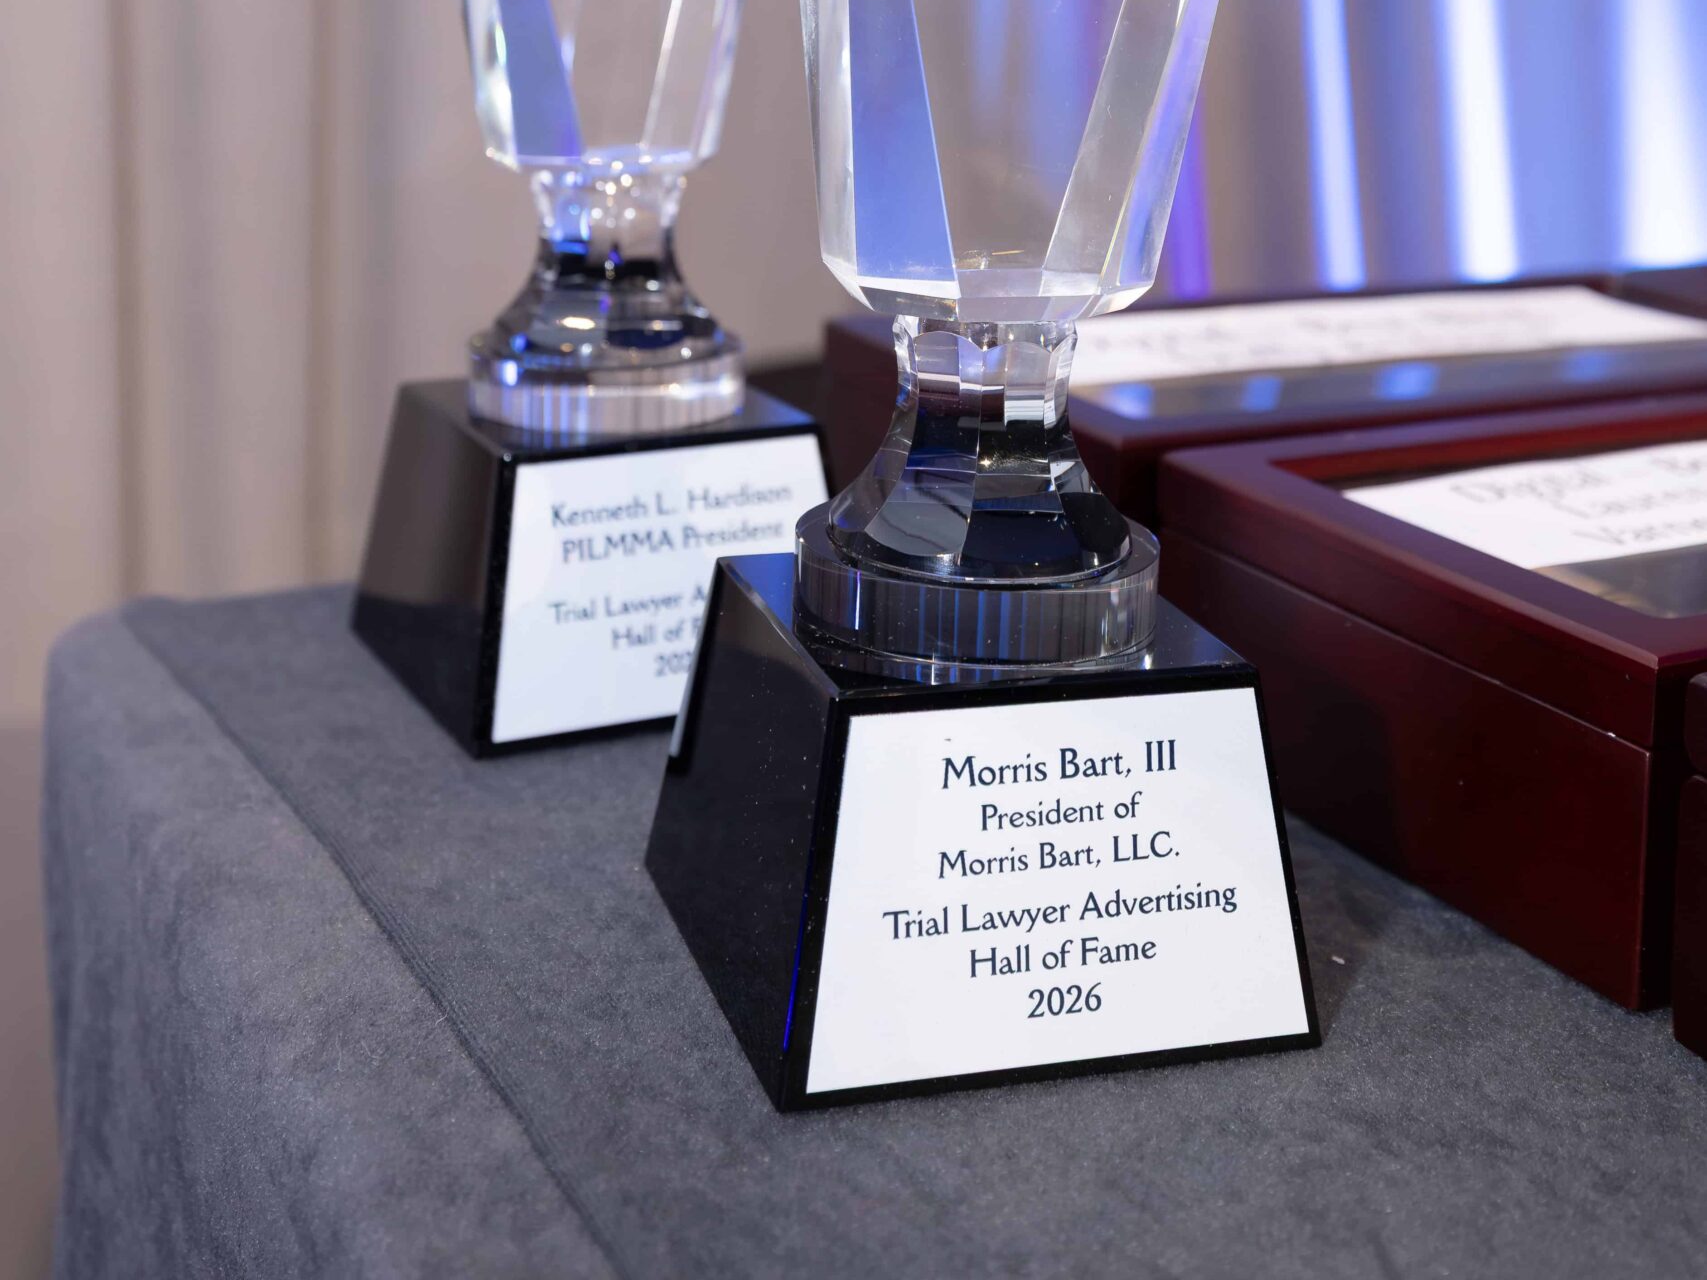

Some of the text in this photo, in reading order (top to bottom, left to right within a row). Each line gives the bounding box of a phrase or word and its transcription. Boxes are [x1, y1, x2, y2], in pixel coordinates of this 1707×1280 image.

[551, 495, 649, 528] Kenneth
[656, 492, 675, 516] L.
[562, 521, 783, 563] PILMMA President
[548, 599, 597, 624] Trial
[603, 593, 684, 618] Lawyer
[611, 623, 657, 650] Hall
[663, 617, 687, 643] of
[942, 739, 1177, 789] Morris Bart, III
[980, 791, 1143, 831] President of
[938, 830, 1180, 878] Morris Bart, LLC.
[882, 882, 1238, 939] Trial Lawyer Advertising
[969, 937, 1157, 977] Hall of Fame
[1027, 982, 1102, 1018] 2026
